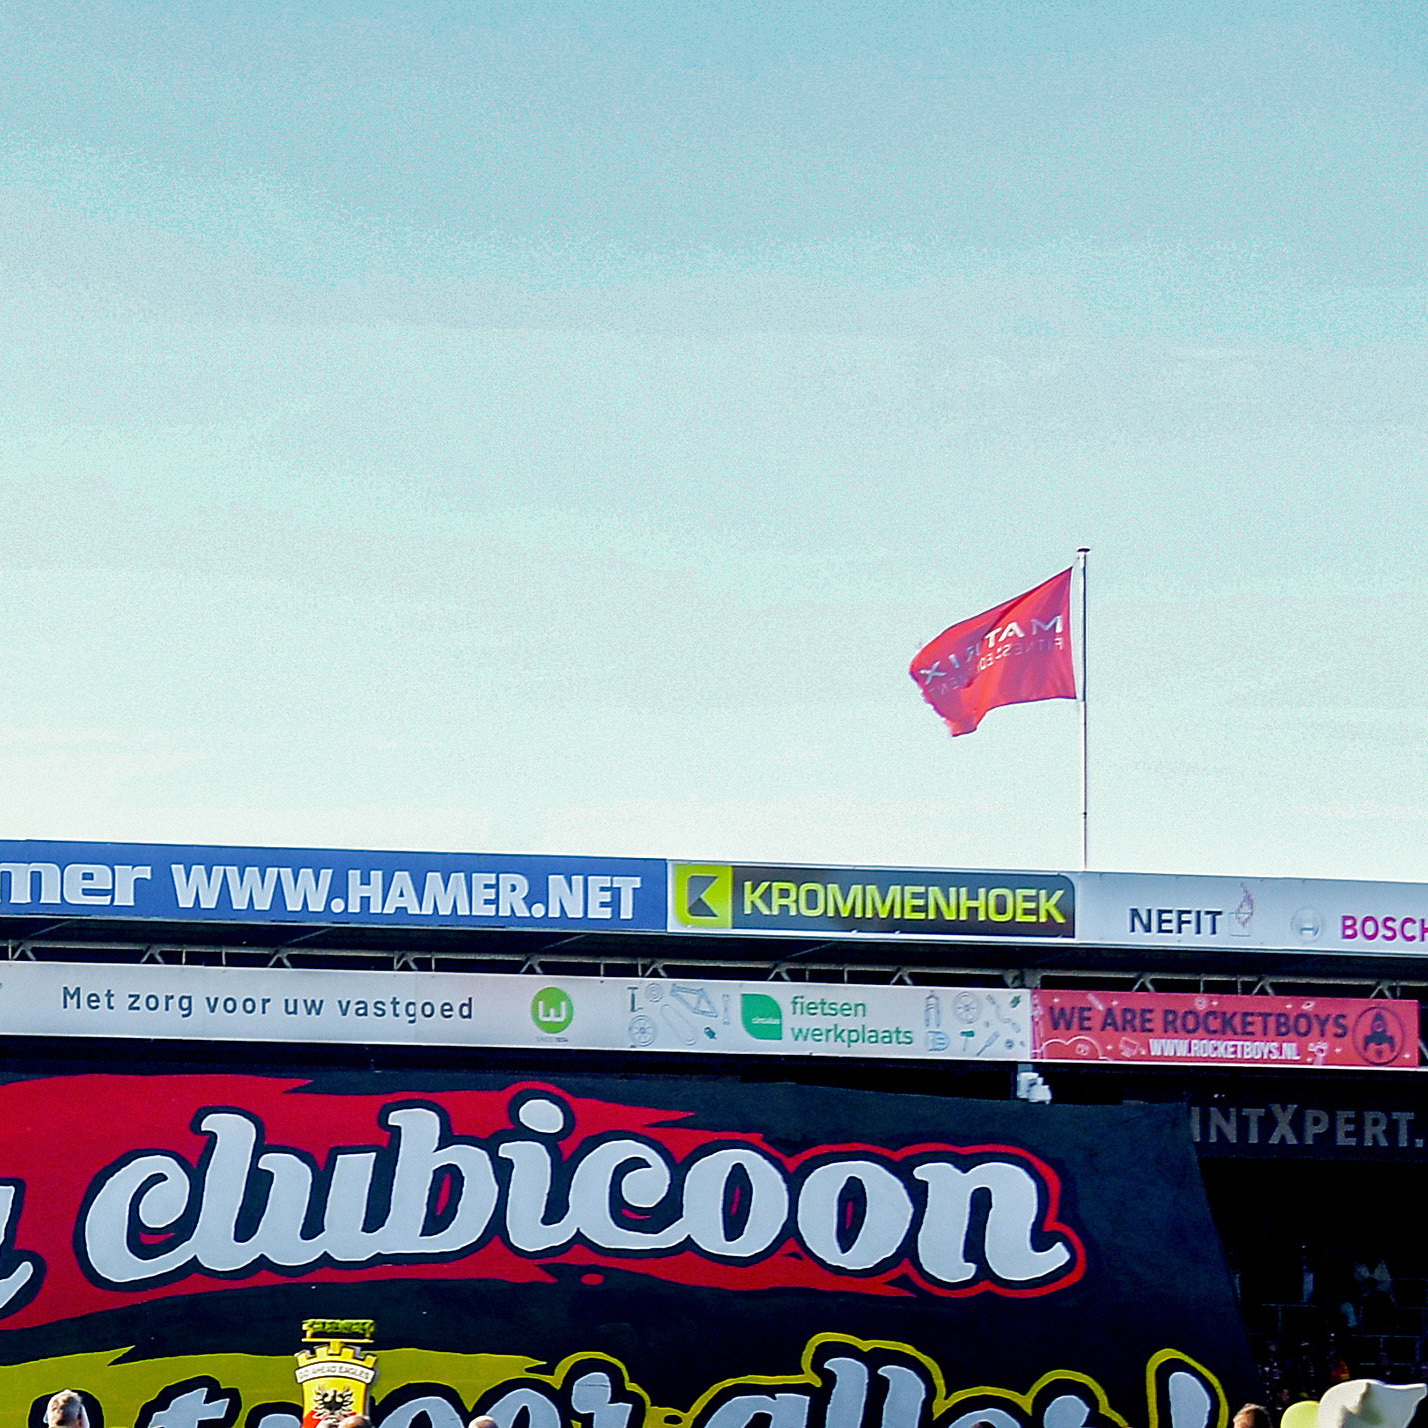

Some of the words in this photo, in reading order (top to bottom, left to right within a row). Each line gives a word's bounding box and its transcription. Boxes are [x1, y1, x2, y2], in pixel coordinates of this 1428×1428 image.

[171, 863, 641, 920] WWW.HAMER.NET
[743, 880, 1066, 924] KROMMENHOEK
[1129, 907, 1224, 936] NEFIT
[62, 985, 115, 1011] Met
[127, 989, 193, 1018] zorg
[205, 994, 271, 1016] voor
[284, 995, 324, 1018] uw
[336, 995, 474, 1025] vastgoed
[790, 994, 866, 1017] fietsen
[791, 1024, 913, 1047] werkplaats
[1049, 1006, 1093, 1031] WE
[1100, 1008, 1154, 1033] ARE
[1163, 1011, 1349, 1039] ROCKETBOYS
[1149, 1038, 1300, 1061] WWW.ROCKETBOYS.NL
[85, 1097, 1071, 1285] clubicoon
